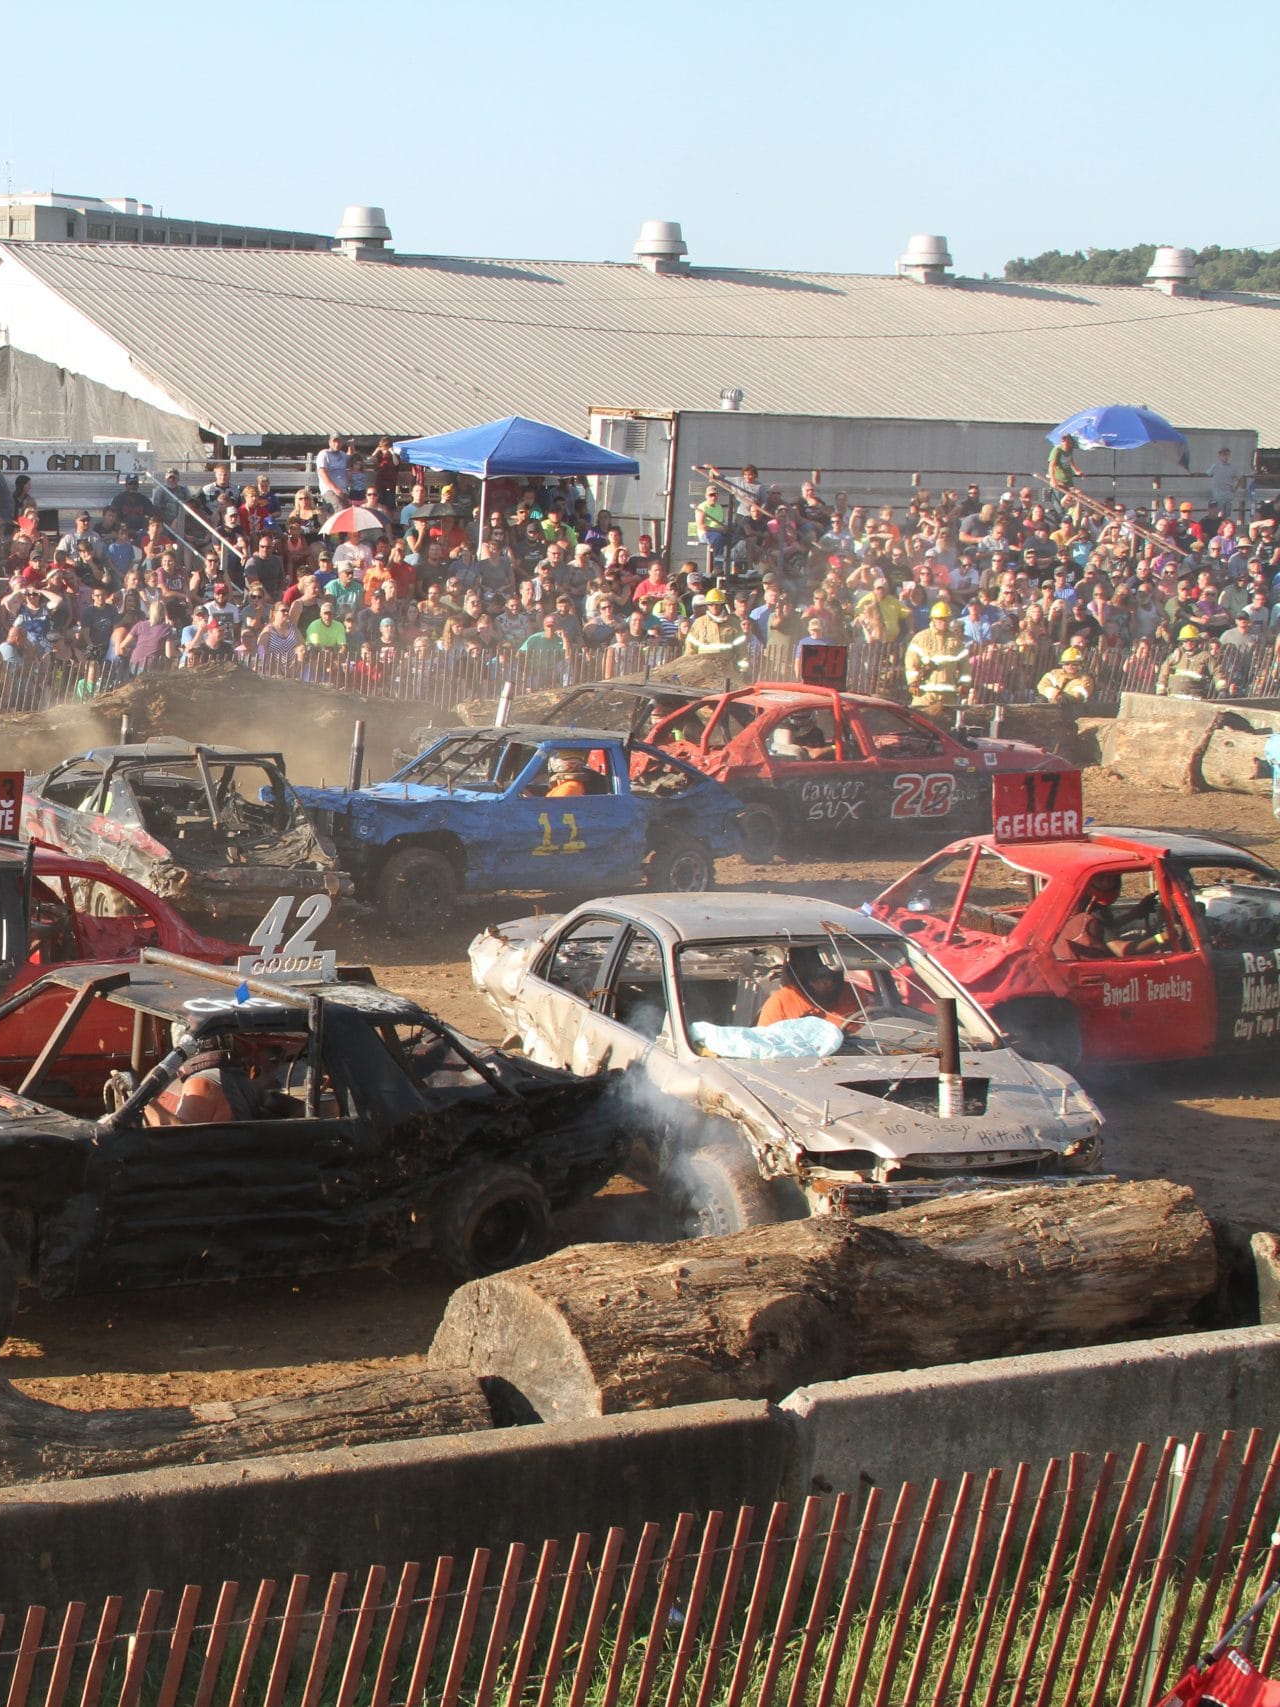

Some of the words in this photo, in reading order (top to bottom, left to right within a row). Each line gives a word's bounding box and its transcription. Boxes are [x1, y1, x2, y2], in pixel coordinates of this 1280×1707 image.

[891, 772, 956, 819] 28
[1024, 773, 1062, 813] 17
[531, 812, 587, 856] 11
[996, 809, 1080, 839] GEIGER
[249, 893, 332, 957] 42
[252, 954, 324, 976] GOODE
[1103, 977, 1140, 1007] Small
